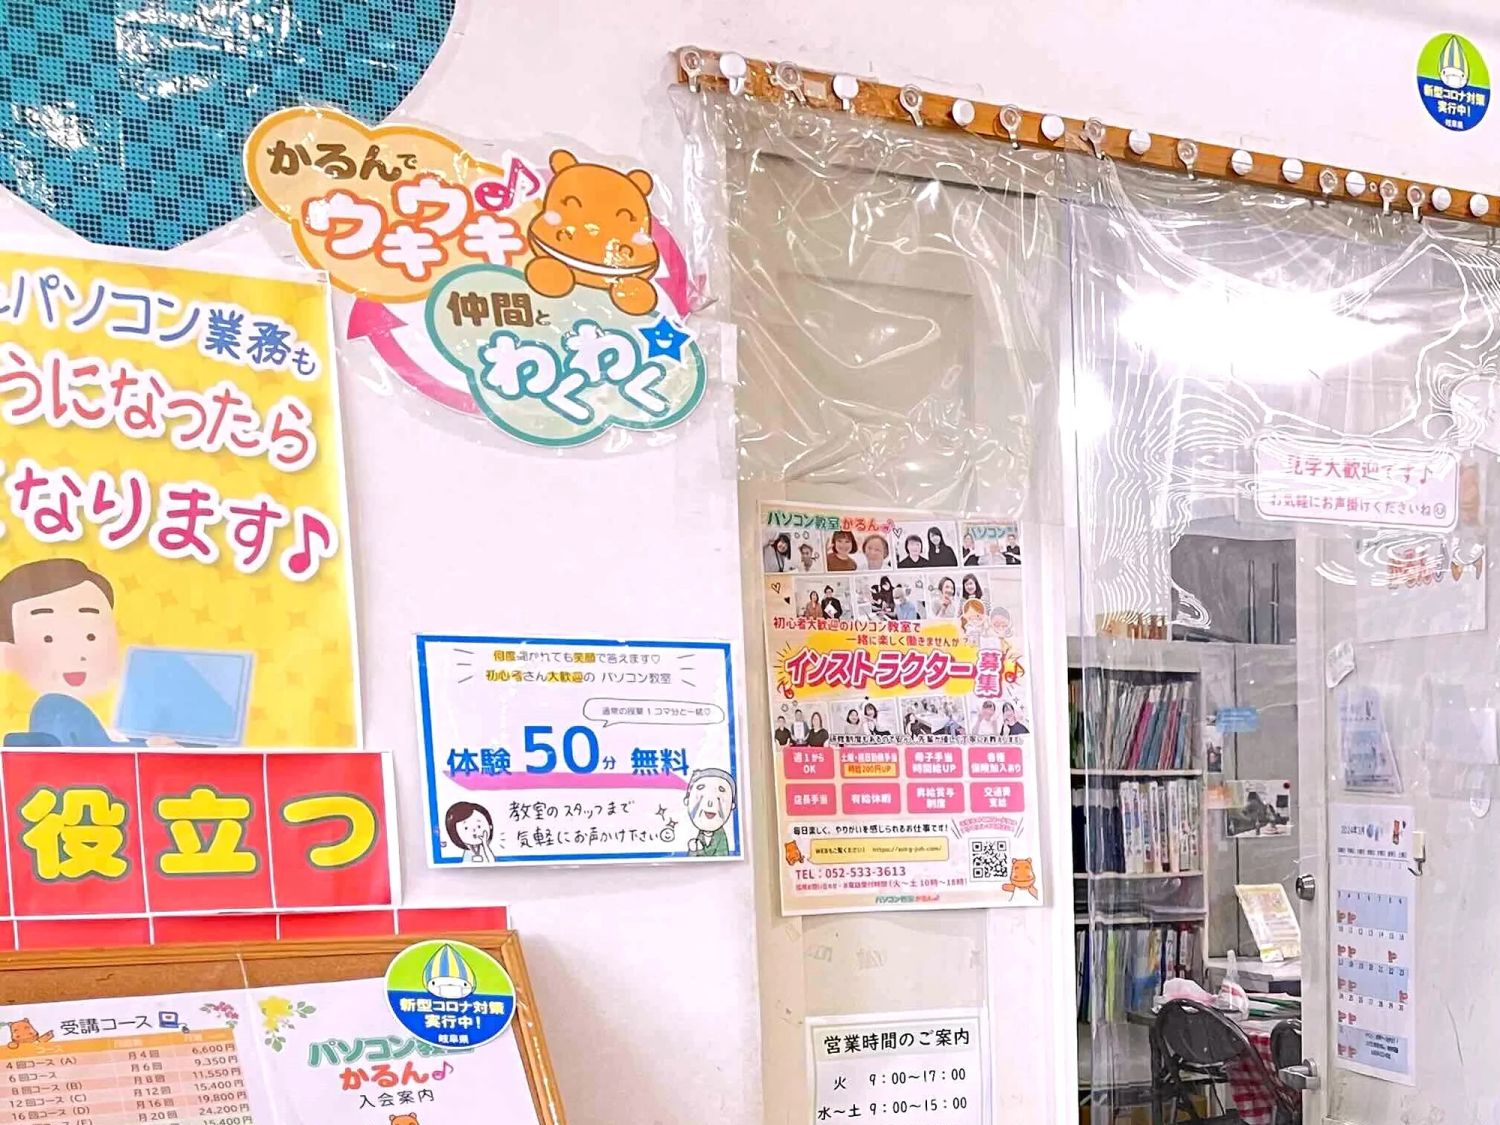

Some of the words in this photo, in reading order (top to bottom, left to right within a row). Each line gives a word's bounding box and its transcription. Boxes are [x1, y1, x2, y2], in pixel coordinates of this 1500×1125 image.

[447, 290, 550, 329] 仲間と
[0, 273, 317, 376] パソコン業務も
[482, 320, 670, 424] わくわく
[0, 350, 311, 464] うになったら
[773, 617, 921, 635] 初心者大歓迎のパソコン教室で
[785, 648, 976, 690] インストラクター
[974, 649, 1003, 698] 募集
[446, 747, 512, 776] 体験
[630, 747, 689, 776] 無料
[22, 788, 376, 881] 役立つ
[400, 997, 505, 1016] 新型コロナ対策
[60, 1014, 151, 1036] 受講コース
[824, 1028, 970, 1055] 営業時間のご案内
[834, 1076, 847, 1090] 火
[359, 1088, 435, 1109] 入会案内
